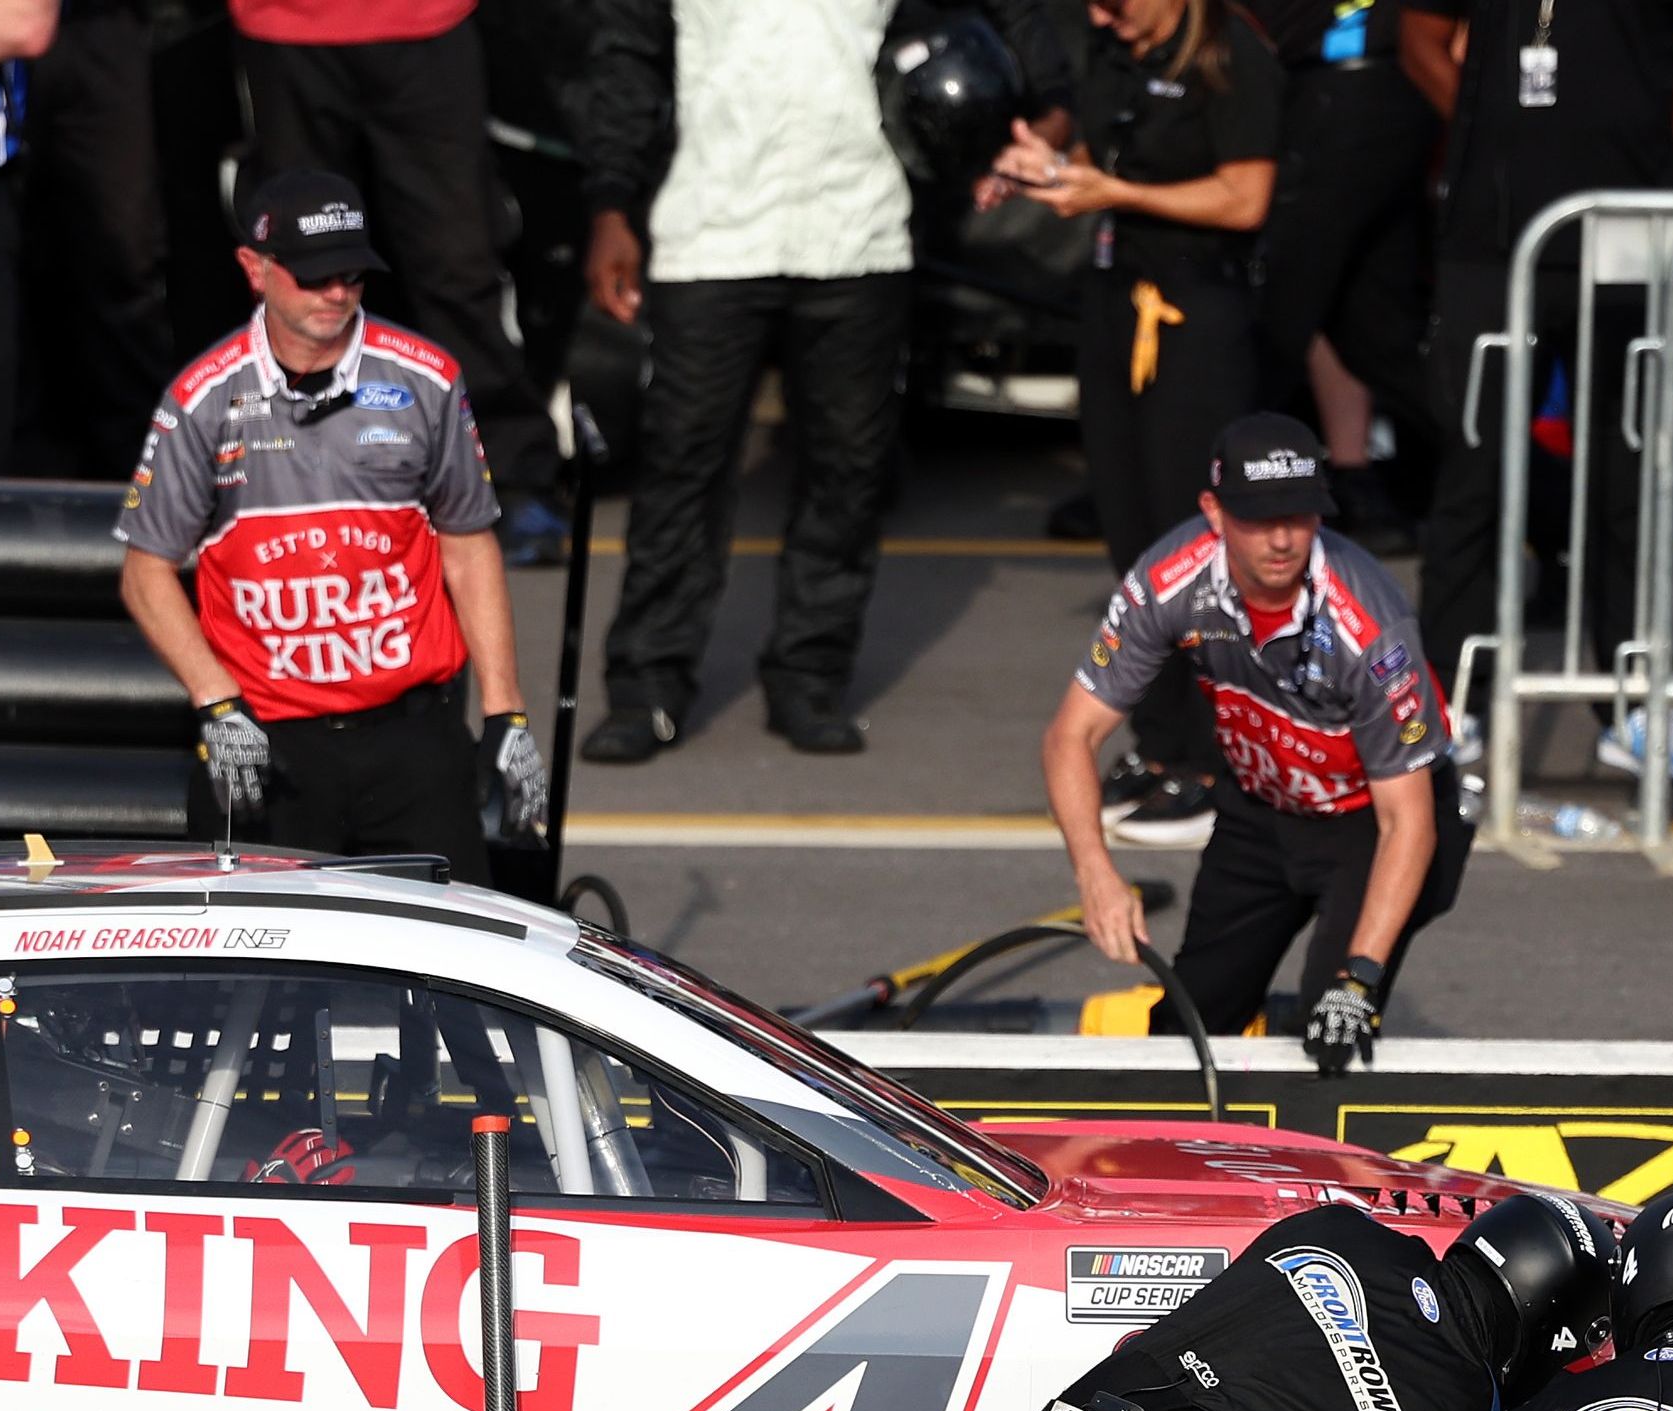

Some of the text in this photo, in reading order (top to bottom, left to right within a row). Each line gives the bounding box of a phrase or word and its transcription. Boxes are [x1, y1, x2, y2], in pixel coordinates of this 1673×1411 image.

[358, 384, 410, 409] Ford
[254, 526, 328, 566] EST'D
[230, 562, 419, 632] RURAL
[261, 617, 414, 685] KING
[14, 929, 86, 953] NOAH
[91, 927, 220, 951] GRAGSON
[1114, 1255, 1206, 1277] NASCAR
[1090, 1286, 1130, 1306] CUP
[1414, 1279, 1440, 1320] Ford
[1294, 1276, 1370, 1411] MOTORSPORTS
[1550, 1326, 1578, 1352] 4
